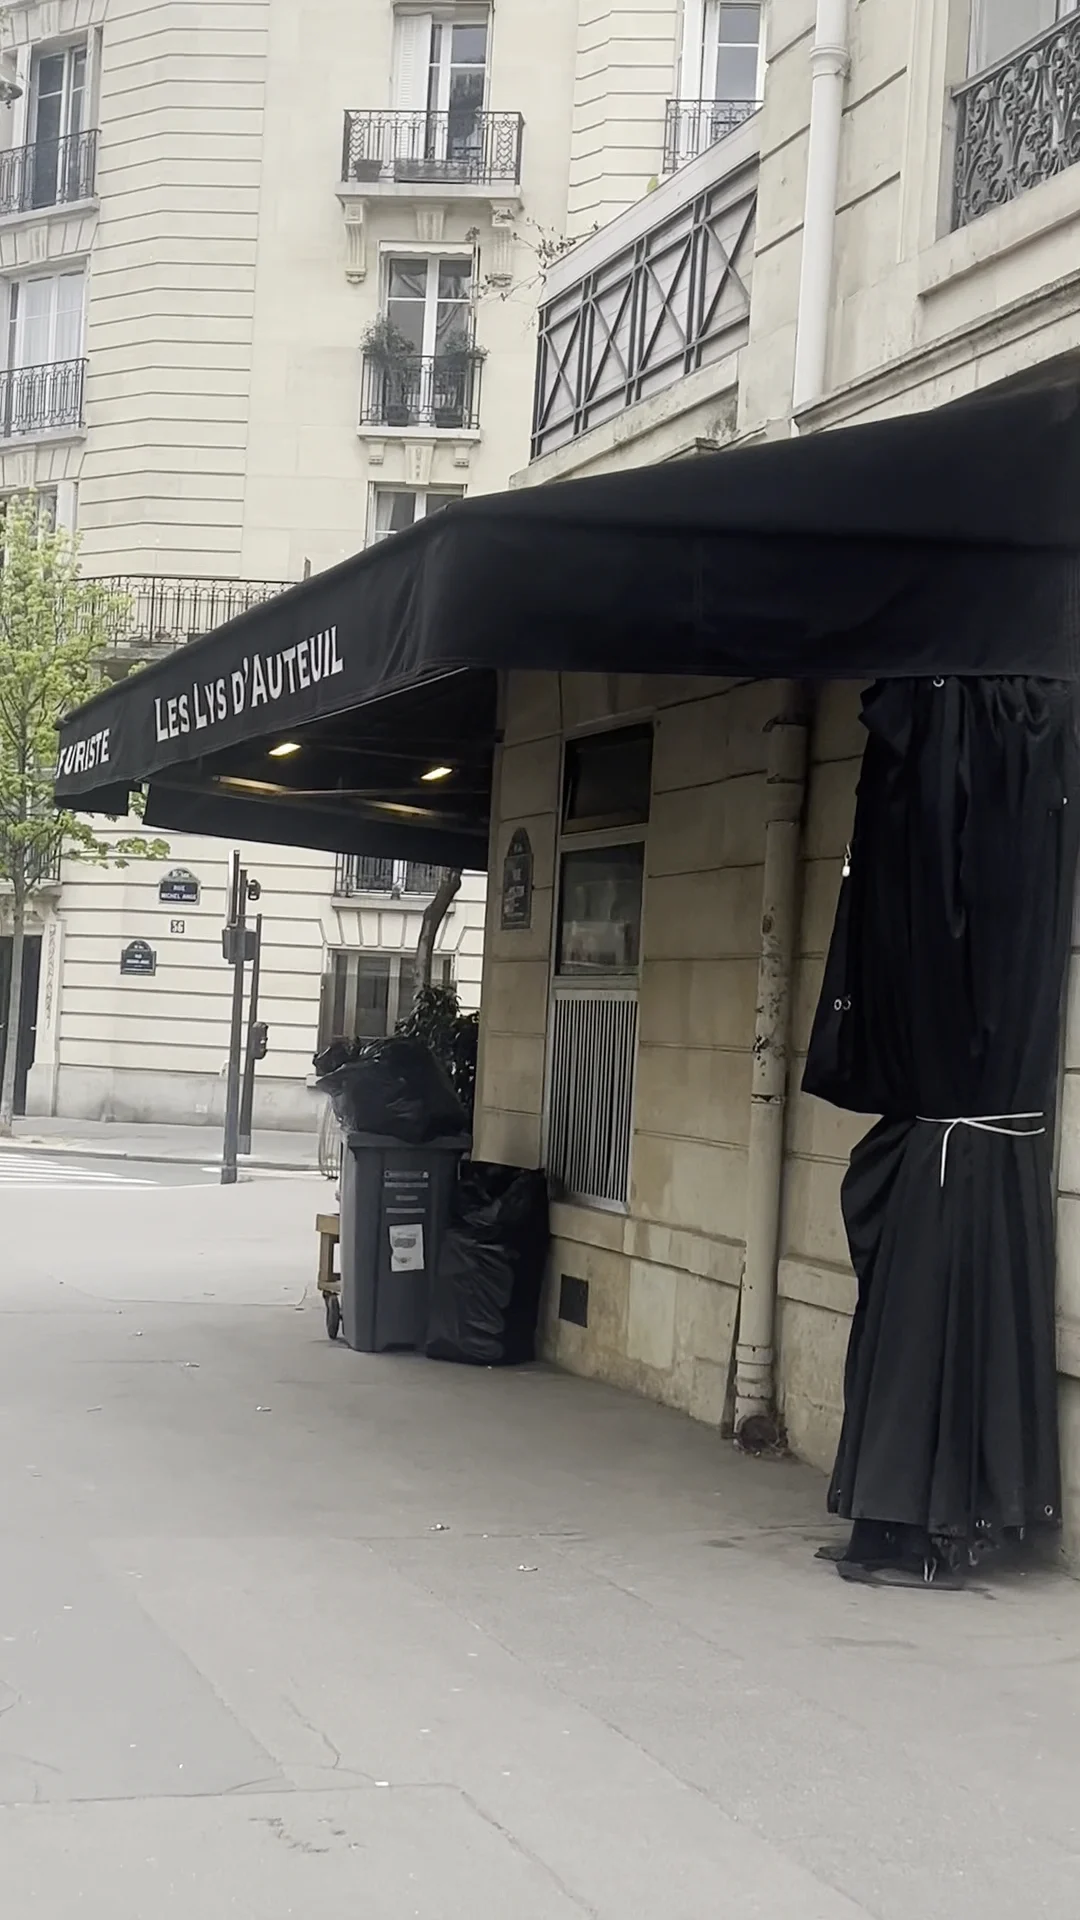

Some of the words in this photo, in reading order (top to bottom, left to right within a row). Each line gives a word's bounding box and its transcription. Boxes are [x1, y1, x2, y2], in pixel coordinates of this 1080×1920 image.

[154, 694, 190, 742] LES
[193, 682, 227, 730] LYS
[231, 625, 343, 715] D'AUTEUIL
